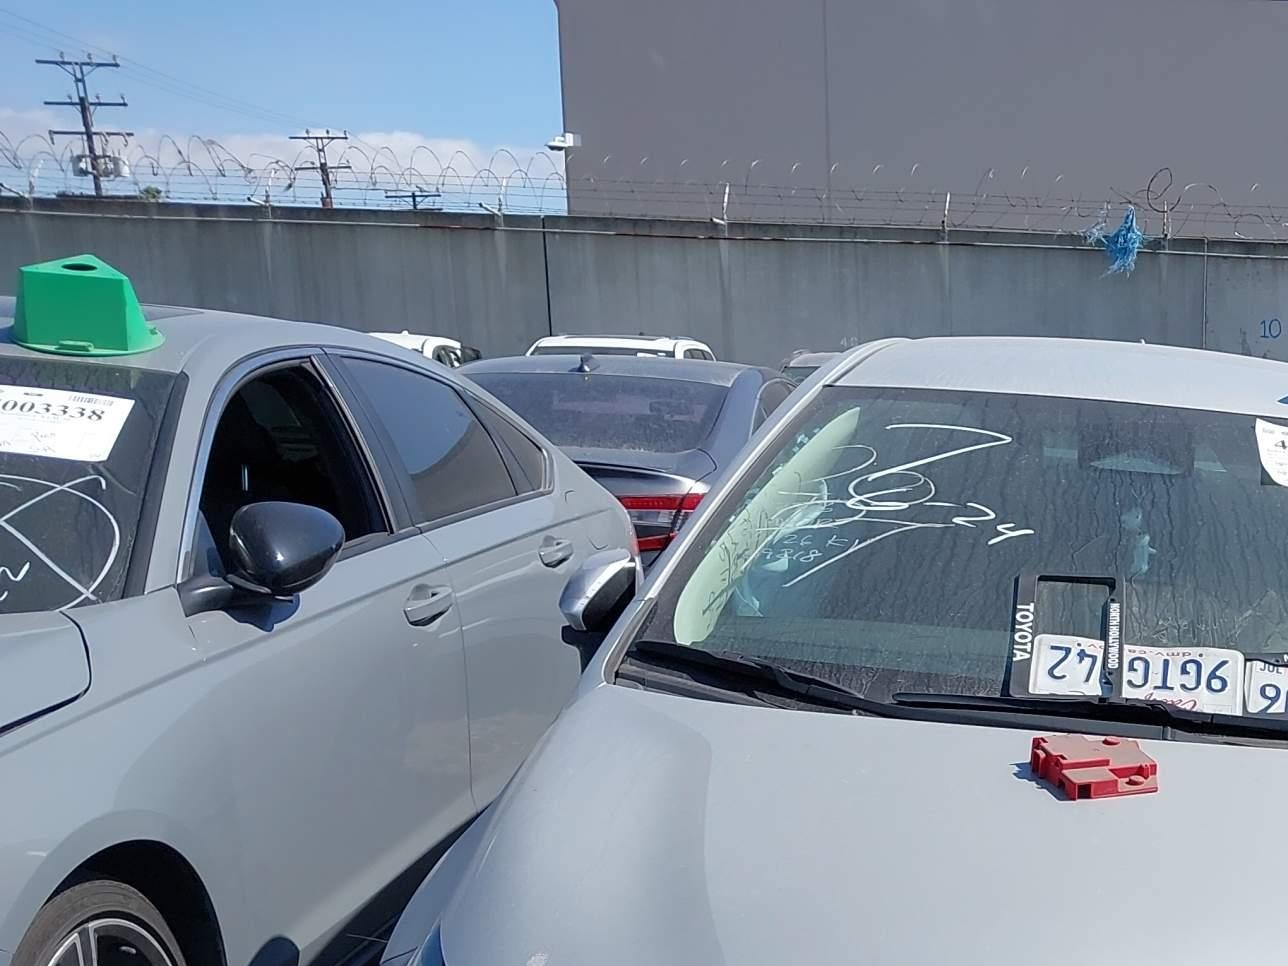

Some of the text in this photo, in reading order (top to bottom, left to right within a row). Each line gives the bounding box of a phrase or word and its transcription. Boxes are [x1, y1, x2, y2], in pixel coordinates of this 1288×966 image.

[1260, 318, 1281, 339] 10
[0, 399, 105, 421] 003338
[1012, 602, 1035, 661] TOYOTA
[1107, 602, 1121, 669] NORTH HOLLYWOOD
[1047, 645, 1230, 694] 9GTG42
[1259, 662, 1282, 675] JUL
